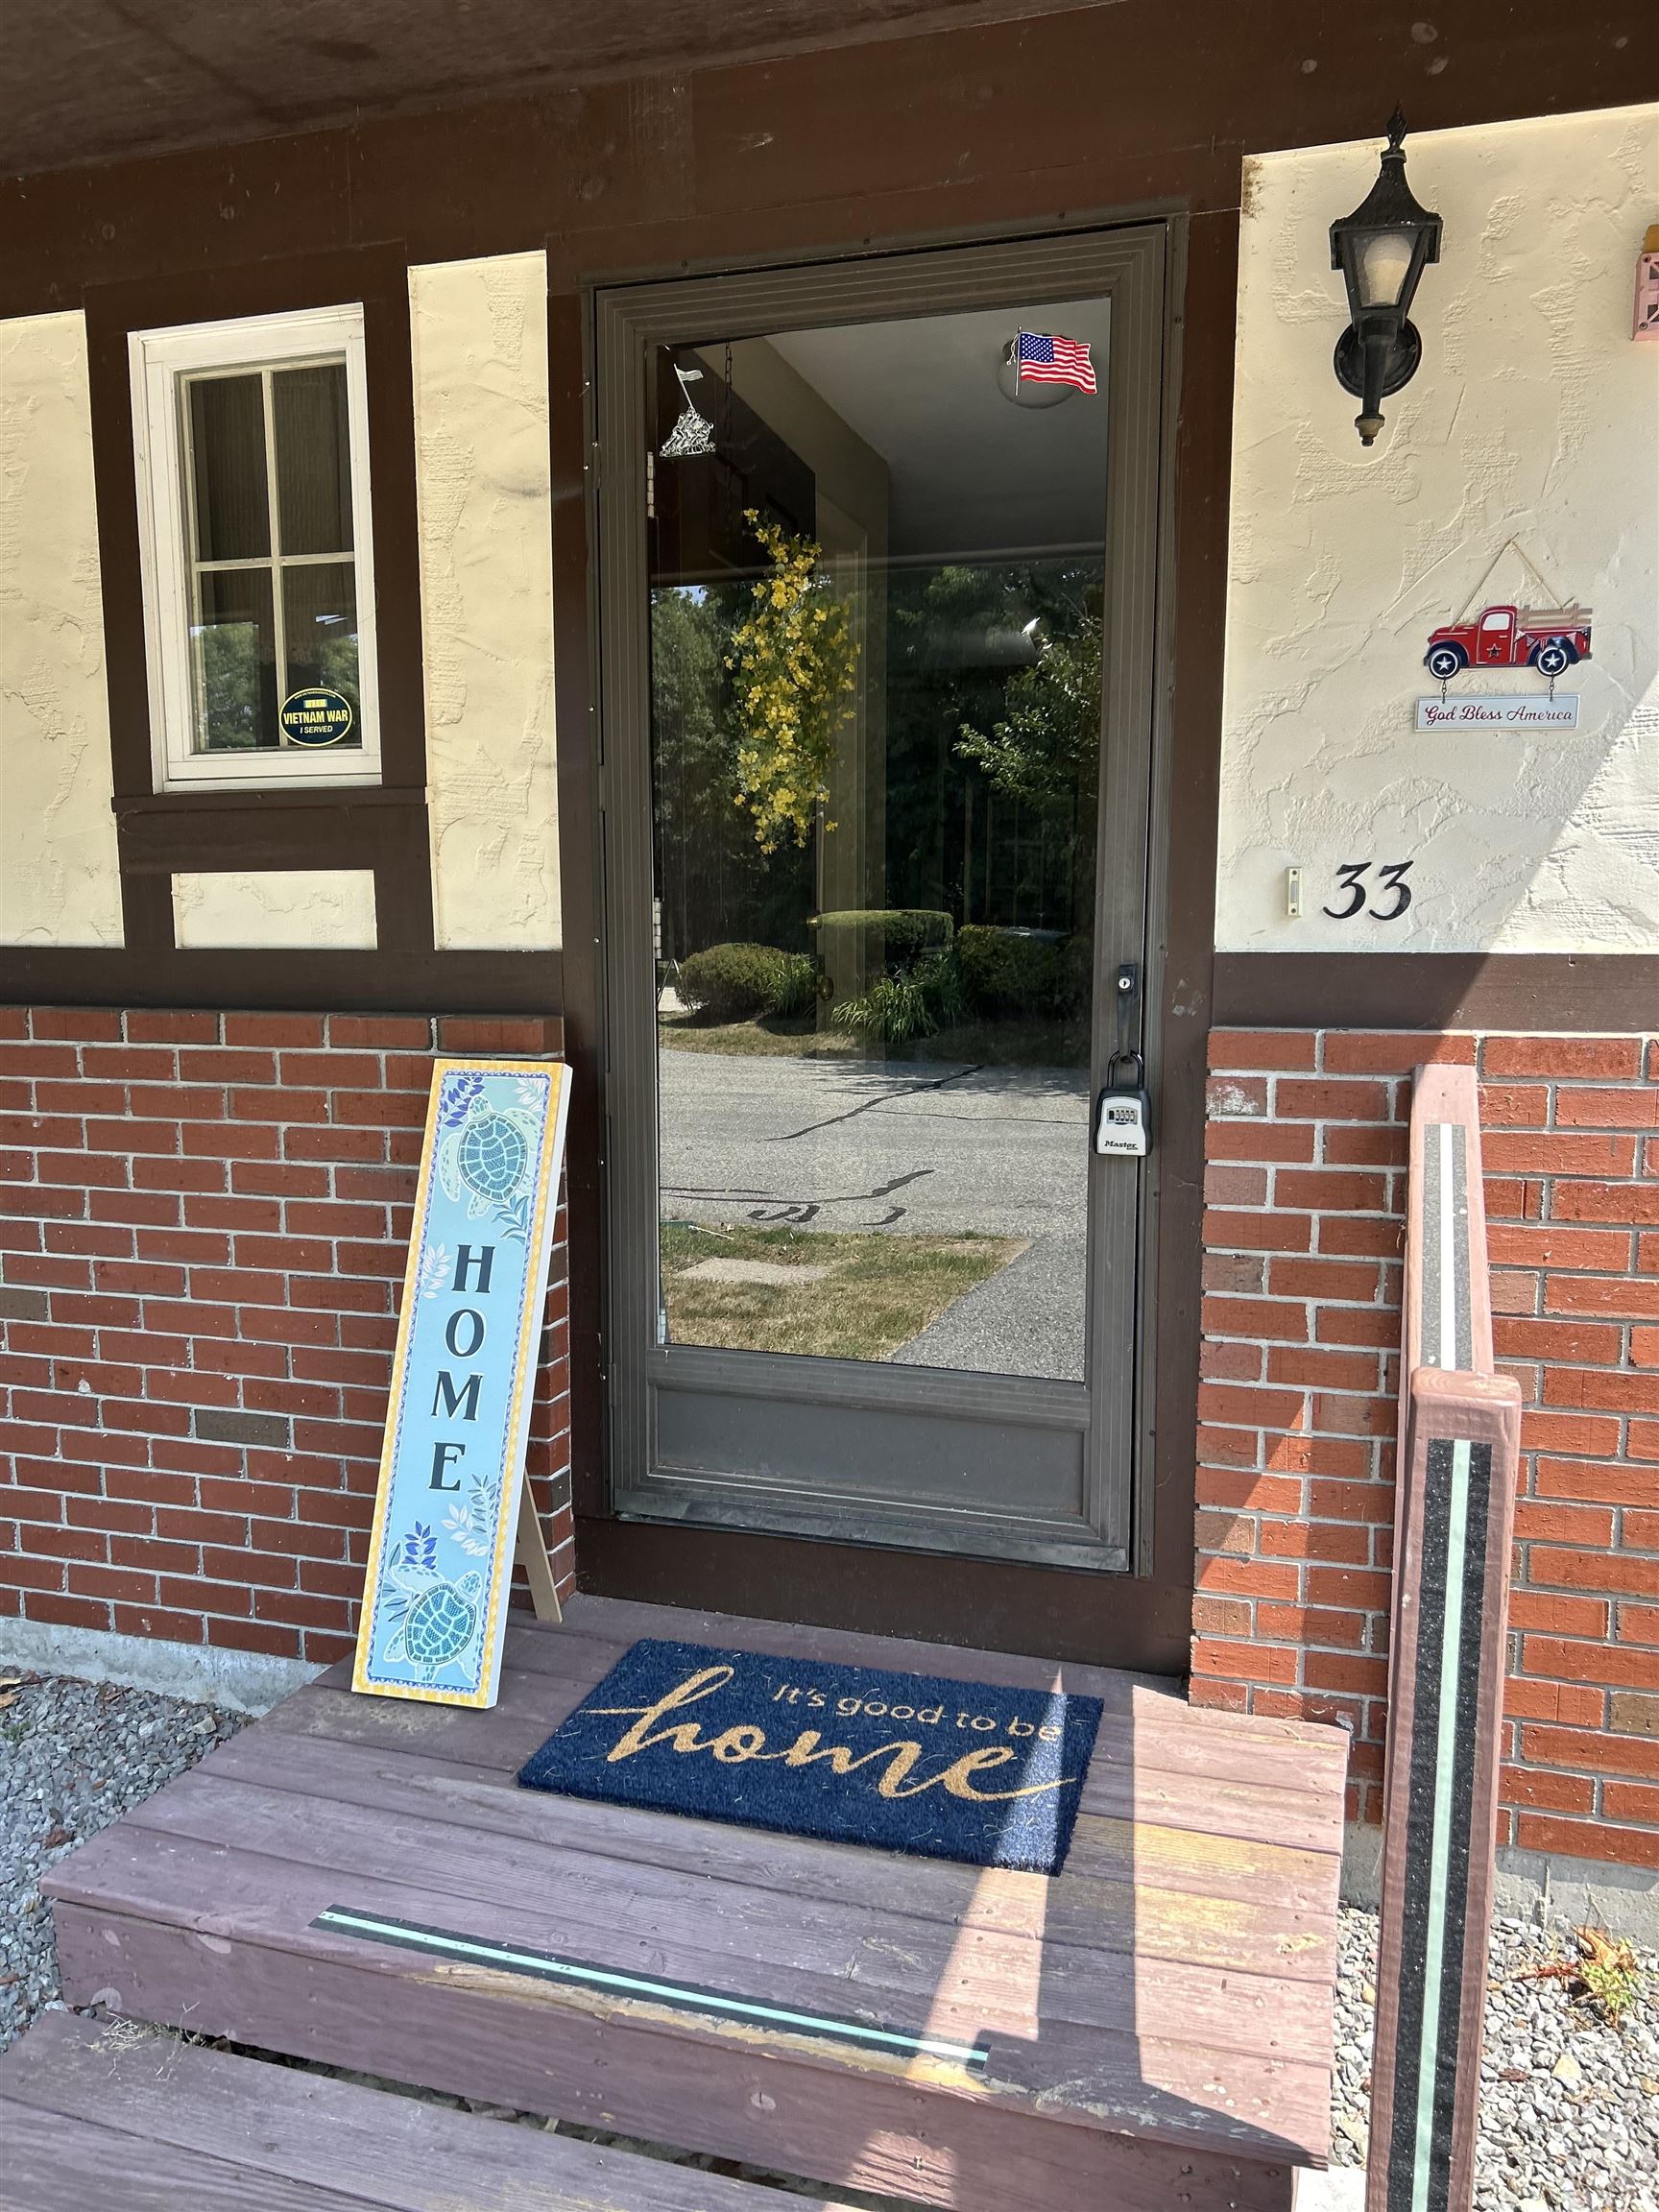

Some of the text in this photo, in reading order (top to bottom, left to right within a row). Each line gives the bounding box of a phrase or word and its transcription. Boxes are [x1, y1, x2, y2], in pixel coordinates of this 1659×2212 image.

[282, 709, 349, 725] VIETNAM WAR
[303, 725, 333, 733] SERVED
[1425, 705, 1574, 727] God Bless America
[1322, 860, 1414, 921] 33
[1104, 1140, 1138, 1148] Master
[427, 1243, 496, 1493] HOME
[579, 1665, 1077, 1802] home
[772, 1684, 1062, 1743] It's good to be
